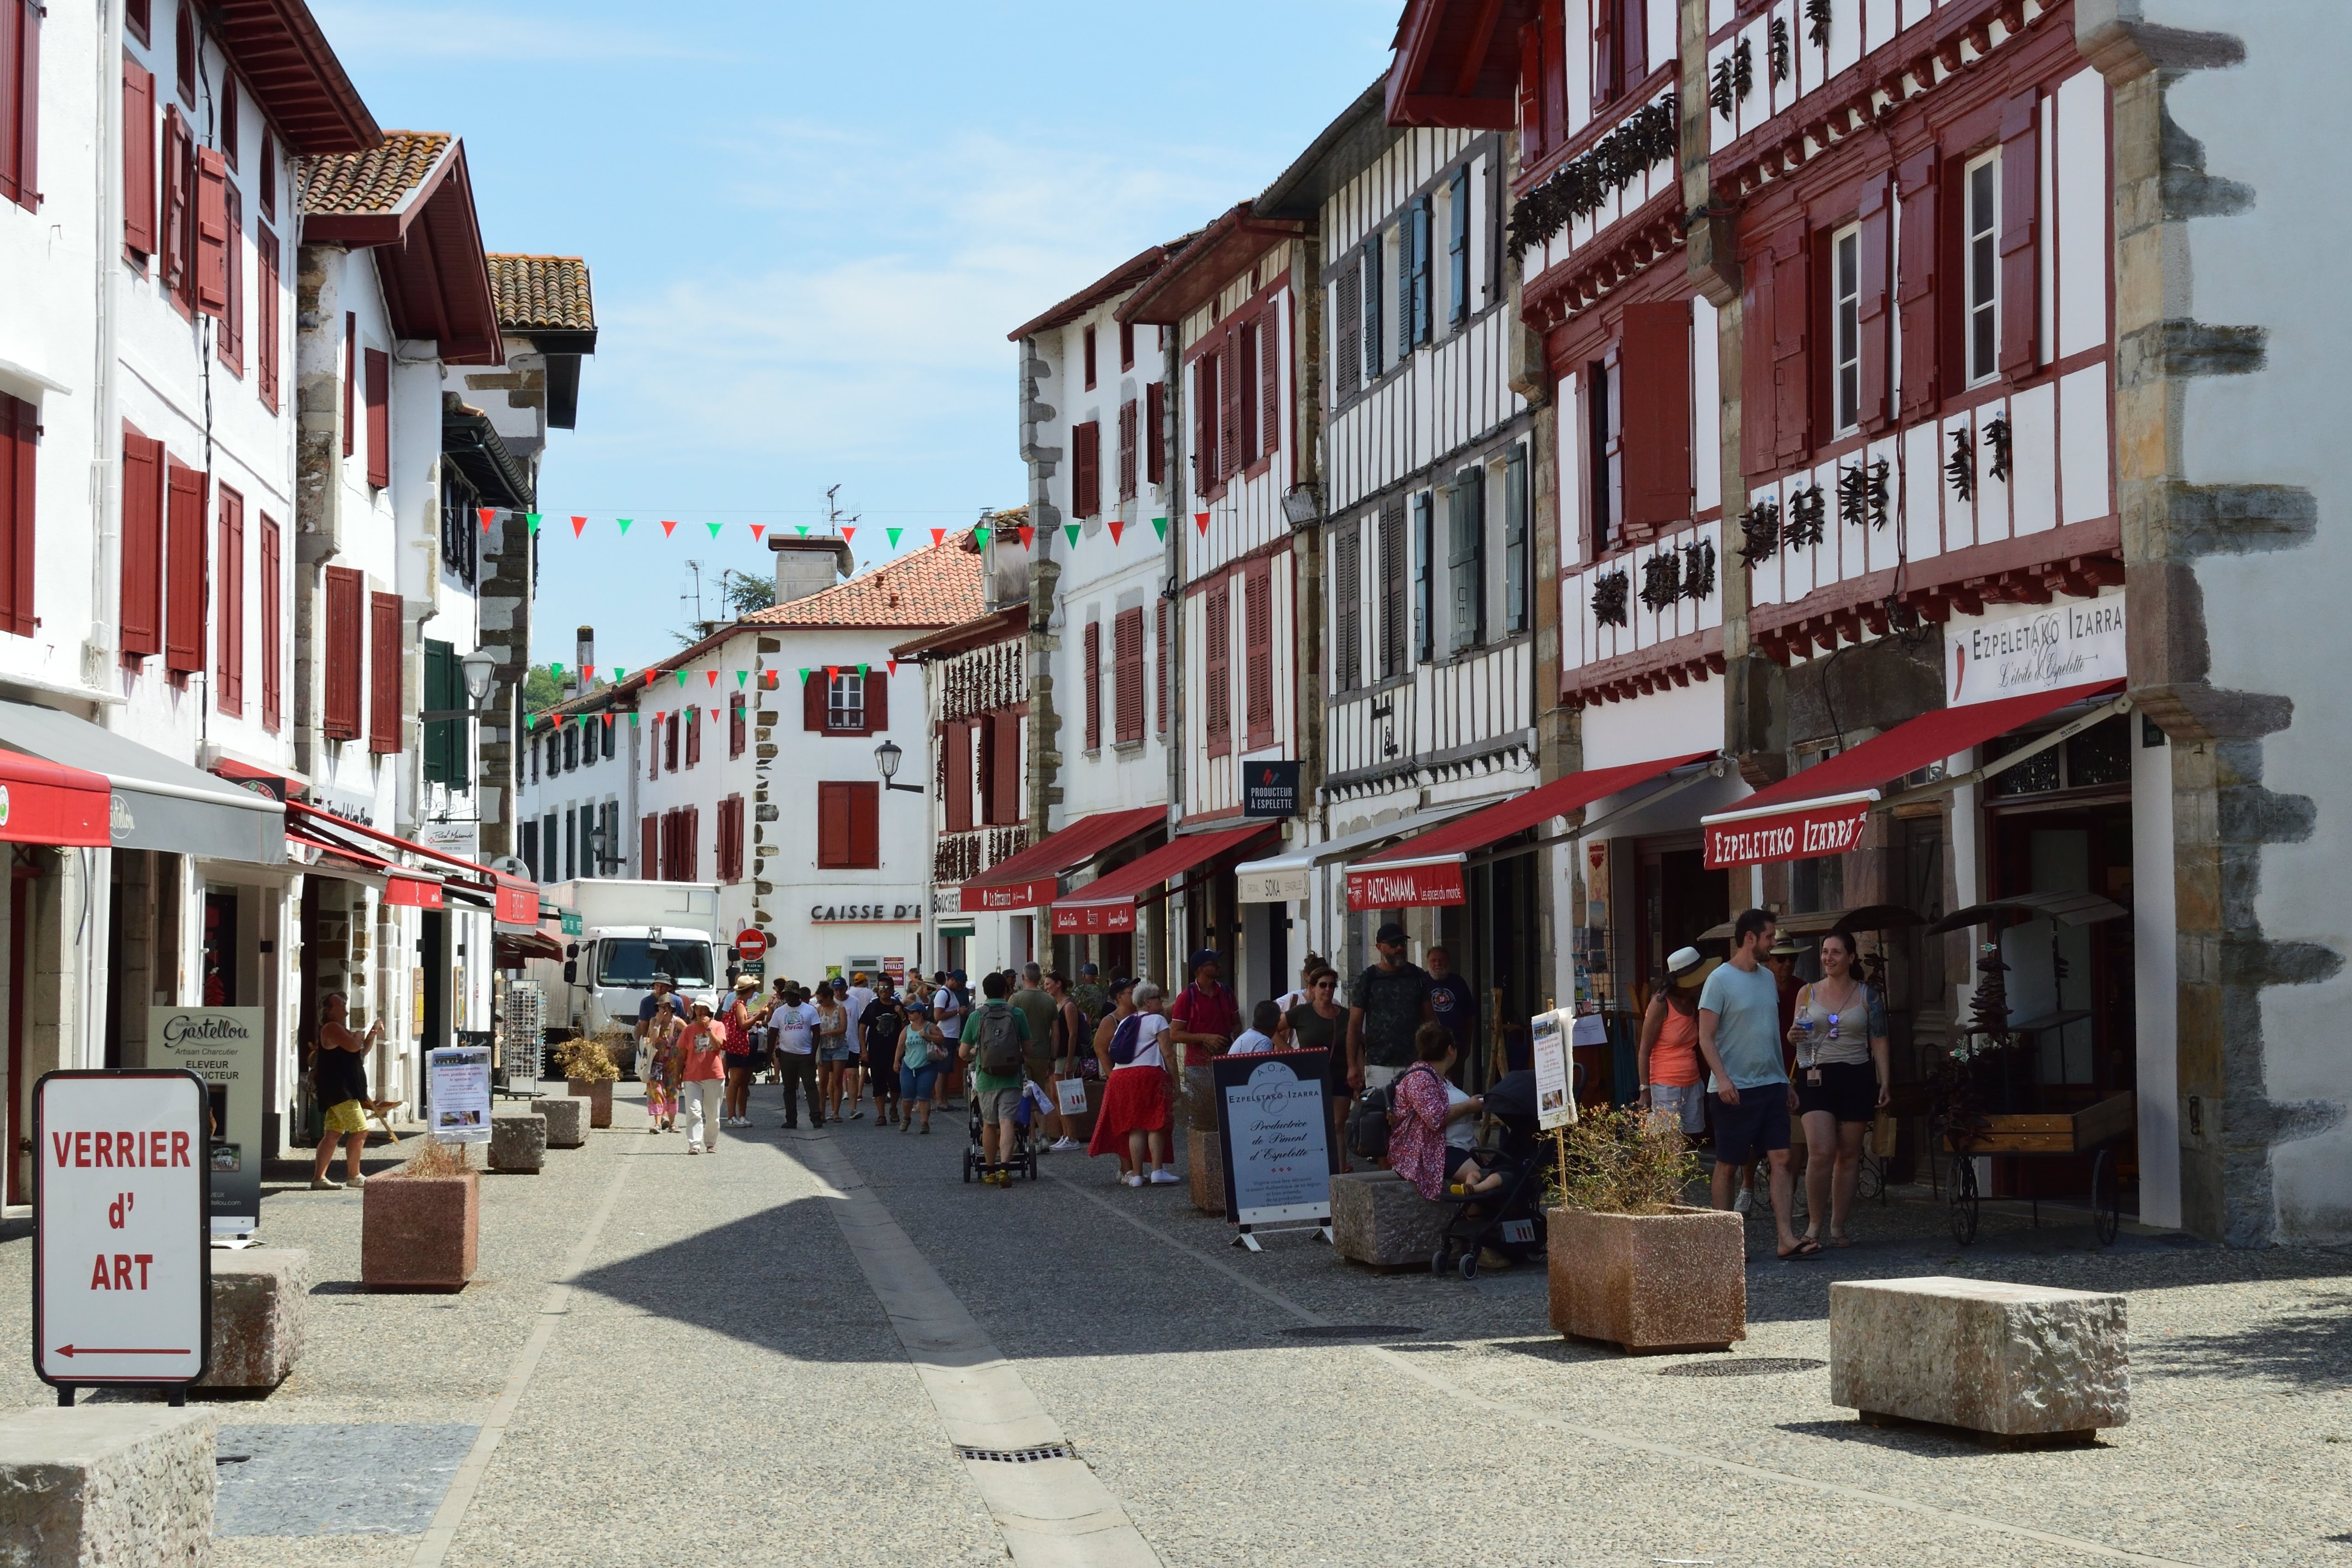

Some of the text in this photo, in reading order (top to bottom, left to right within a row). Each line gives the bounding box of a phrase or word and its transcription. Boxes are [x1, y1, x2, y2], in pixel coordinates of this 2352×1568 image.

[1973, 606, 2122, 660] EZPELETAKO IZARRA
[1251, 787, 1292, 797] PRODUCTEUR
[1251, 798, 1292, 809] À ESPELETTE
[1714, 818, 1855, 862] EZPELETAKO IZARRA
[1265, 878, 1281, 896] SOKA
[1368, 875, 1417, 904] PATCHAMAMA
[1439, 884, 1445, 899] du
[811, 905, 921, 920] CAISSE D'E
[934, 890, 960, 915] BOUCHERi
[163, 1015, 250, 1048] Gastellou
[1229, 1093, 1283, 1103] EZPELETAKO
[1250, 1120, 1307, 1131] Productrice
[52, 1131, 191, 1167] VERRIER
[1252, 1133, 1307, 1145] de Piment
[1249, 1147, 1309, 1161] d'Espelette
[109, 1192, 133, 1229] d'
[91, 1254, 153, 1290] ART
